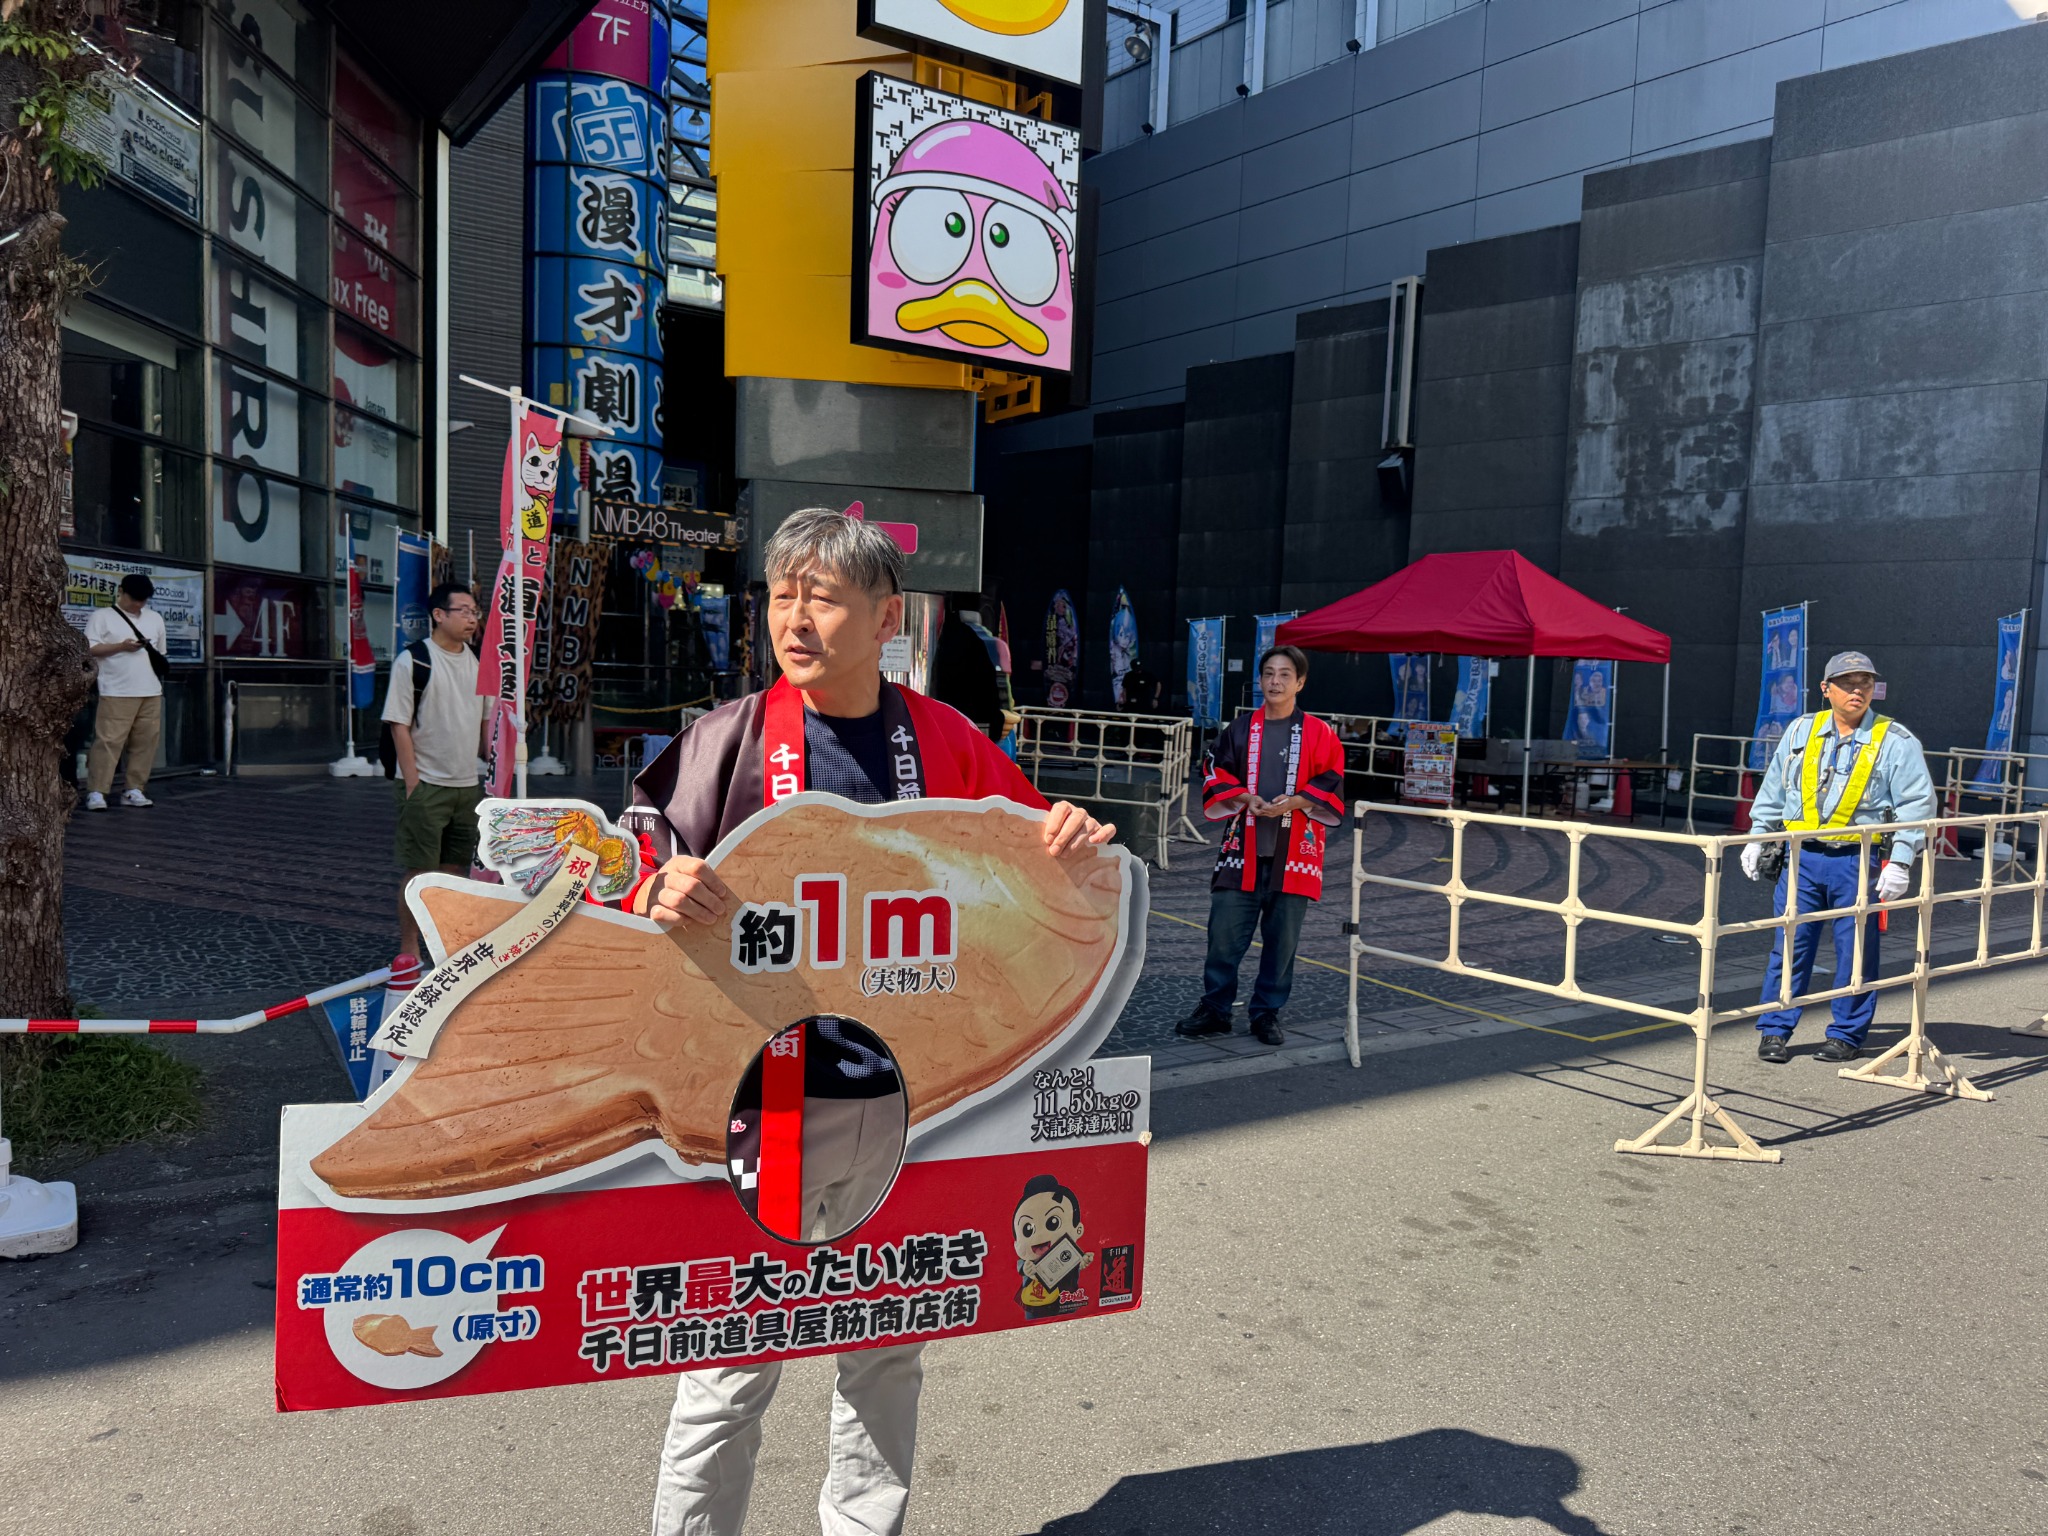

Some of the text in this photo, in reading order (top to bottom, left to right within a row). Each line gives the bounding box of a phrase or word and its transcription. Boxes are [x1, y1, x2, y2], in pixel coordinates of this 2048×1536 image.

[591, 12, 631, 45] 7F
[581, 114, 636, 162] 5F
[355, 281, 390, 331] Free
[580, 180, 640, 500] 漫才劇場
[526, 509, 545, 530] 道
[594, 504, 669, 539] NMB48
[669, 521, 722, 545] Theater
[69, 572, 117, 596] けられます
[164, 607, 189, 621] cloak
[252, 597, 296, 658] 4F
[770, 743, 800, 801] 千日
[891, 725, 921, 801] 千日前
[566, 856, 592, 880] 祝
[382, 942, 496, 1048] 世界記録認定
[861, 965, 956, 996] (実物大)
[349, 996, 368, 1063] 駐輪禁止
[1034, 1067, 1094, 1089] なんと!
[1034, 1088, 1140, 1118] 11.58kgの
[1031, 1112, 1133, 1141] 大記録達成!!
[302, 1255, 542, 1306] 通常約10cm
[580, 1232, 986, 1322] 世界最大のたい焼き
[1102, 1256, 1131, 1294] 道
[452, 1308, 538, 1343] (原寸)
[581, 1288, 979, 1370] 千日前道具屋筋商店街
